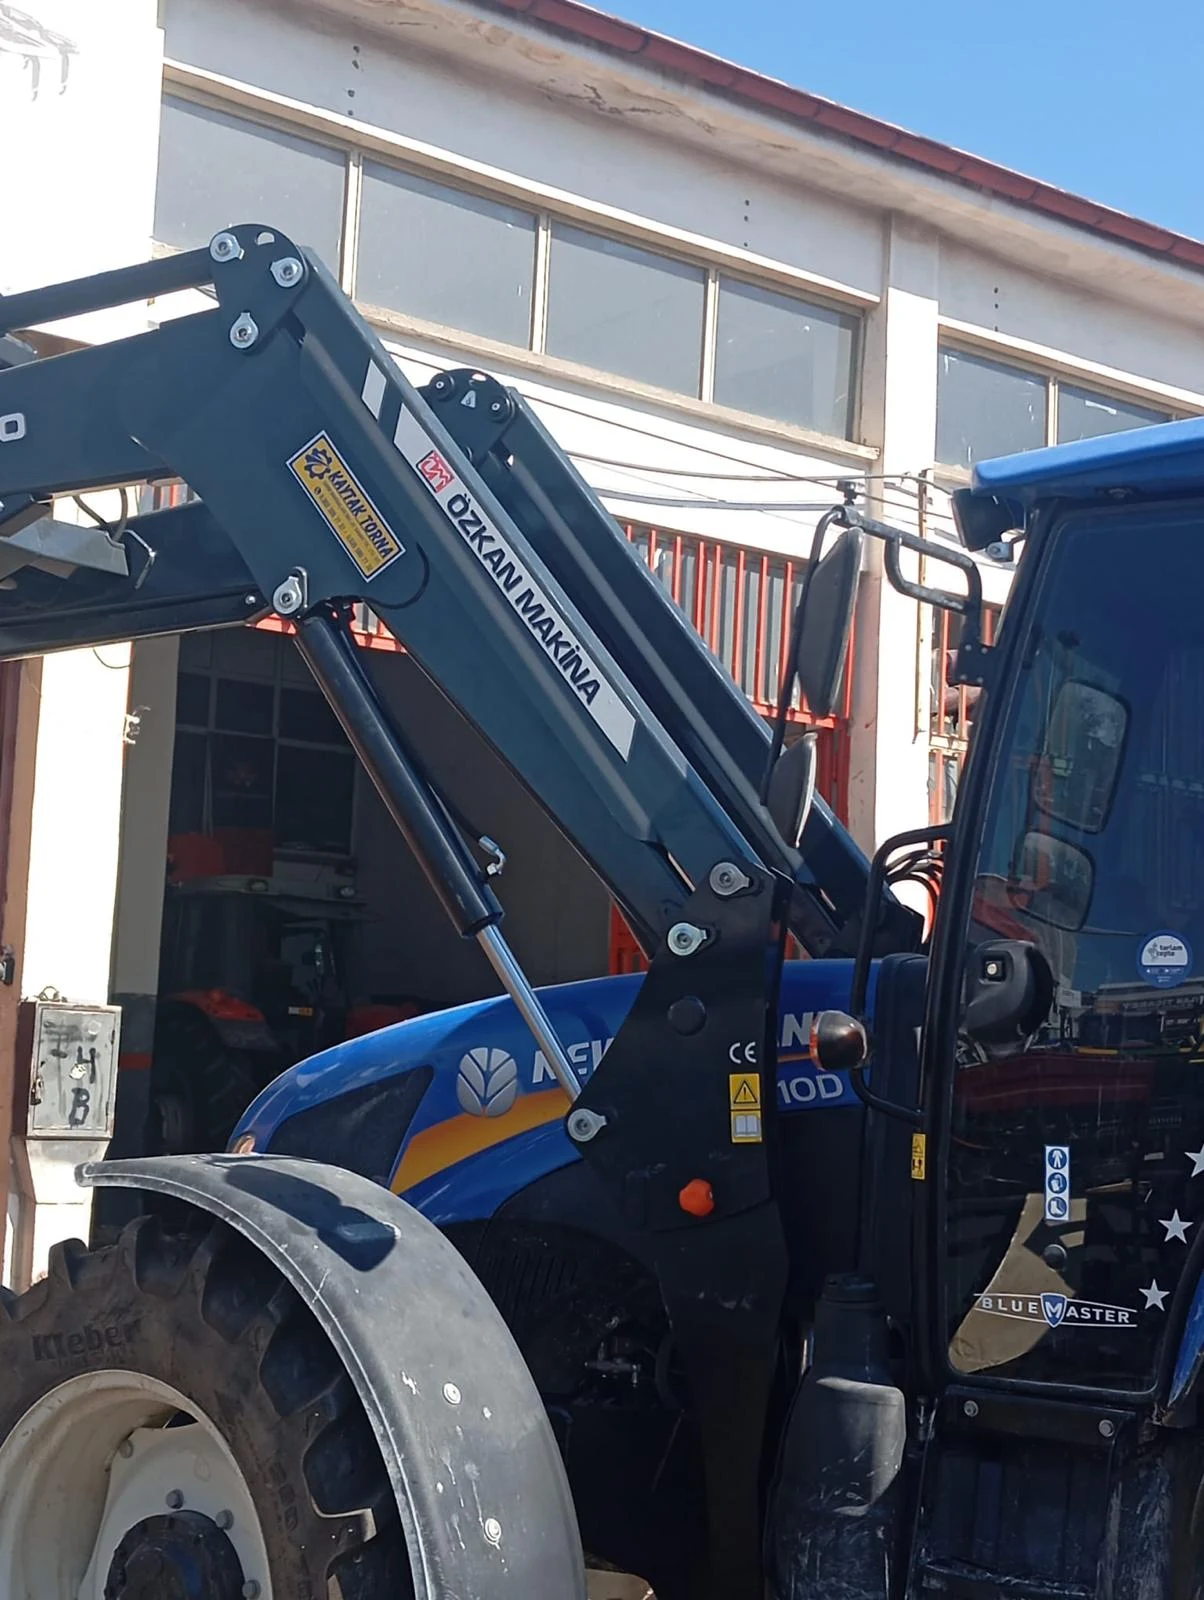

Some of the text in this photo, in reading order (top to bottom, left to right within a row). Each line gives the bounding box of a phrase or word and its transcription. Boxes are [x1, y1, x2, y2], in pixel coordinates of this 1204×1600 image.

[327, 470, 367, 518] KAYTAK
[359, 514, 395, 560] TORNA
[447, 492, 601, 706] ÖZKAN MAKİNA
[729, 1041, 757, 1064] CE
